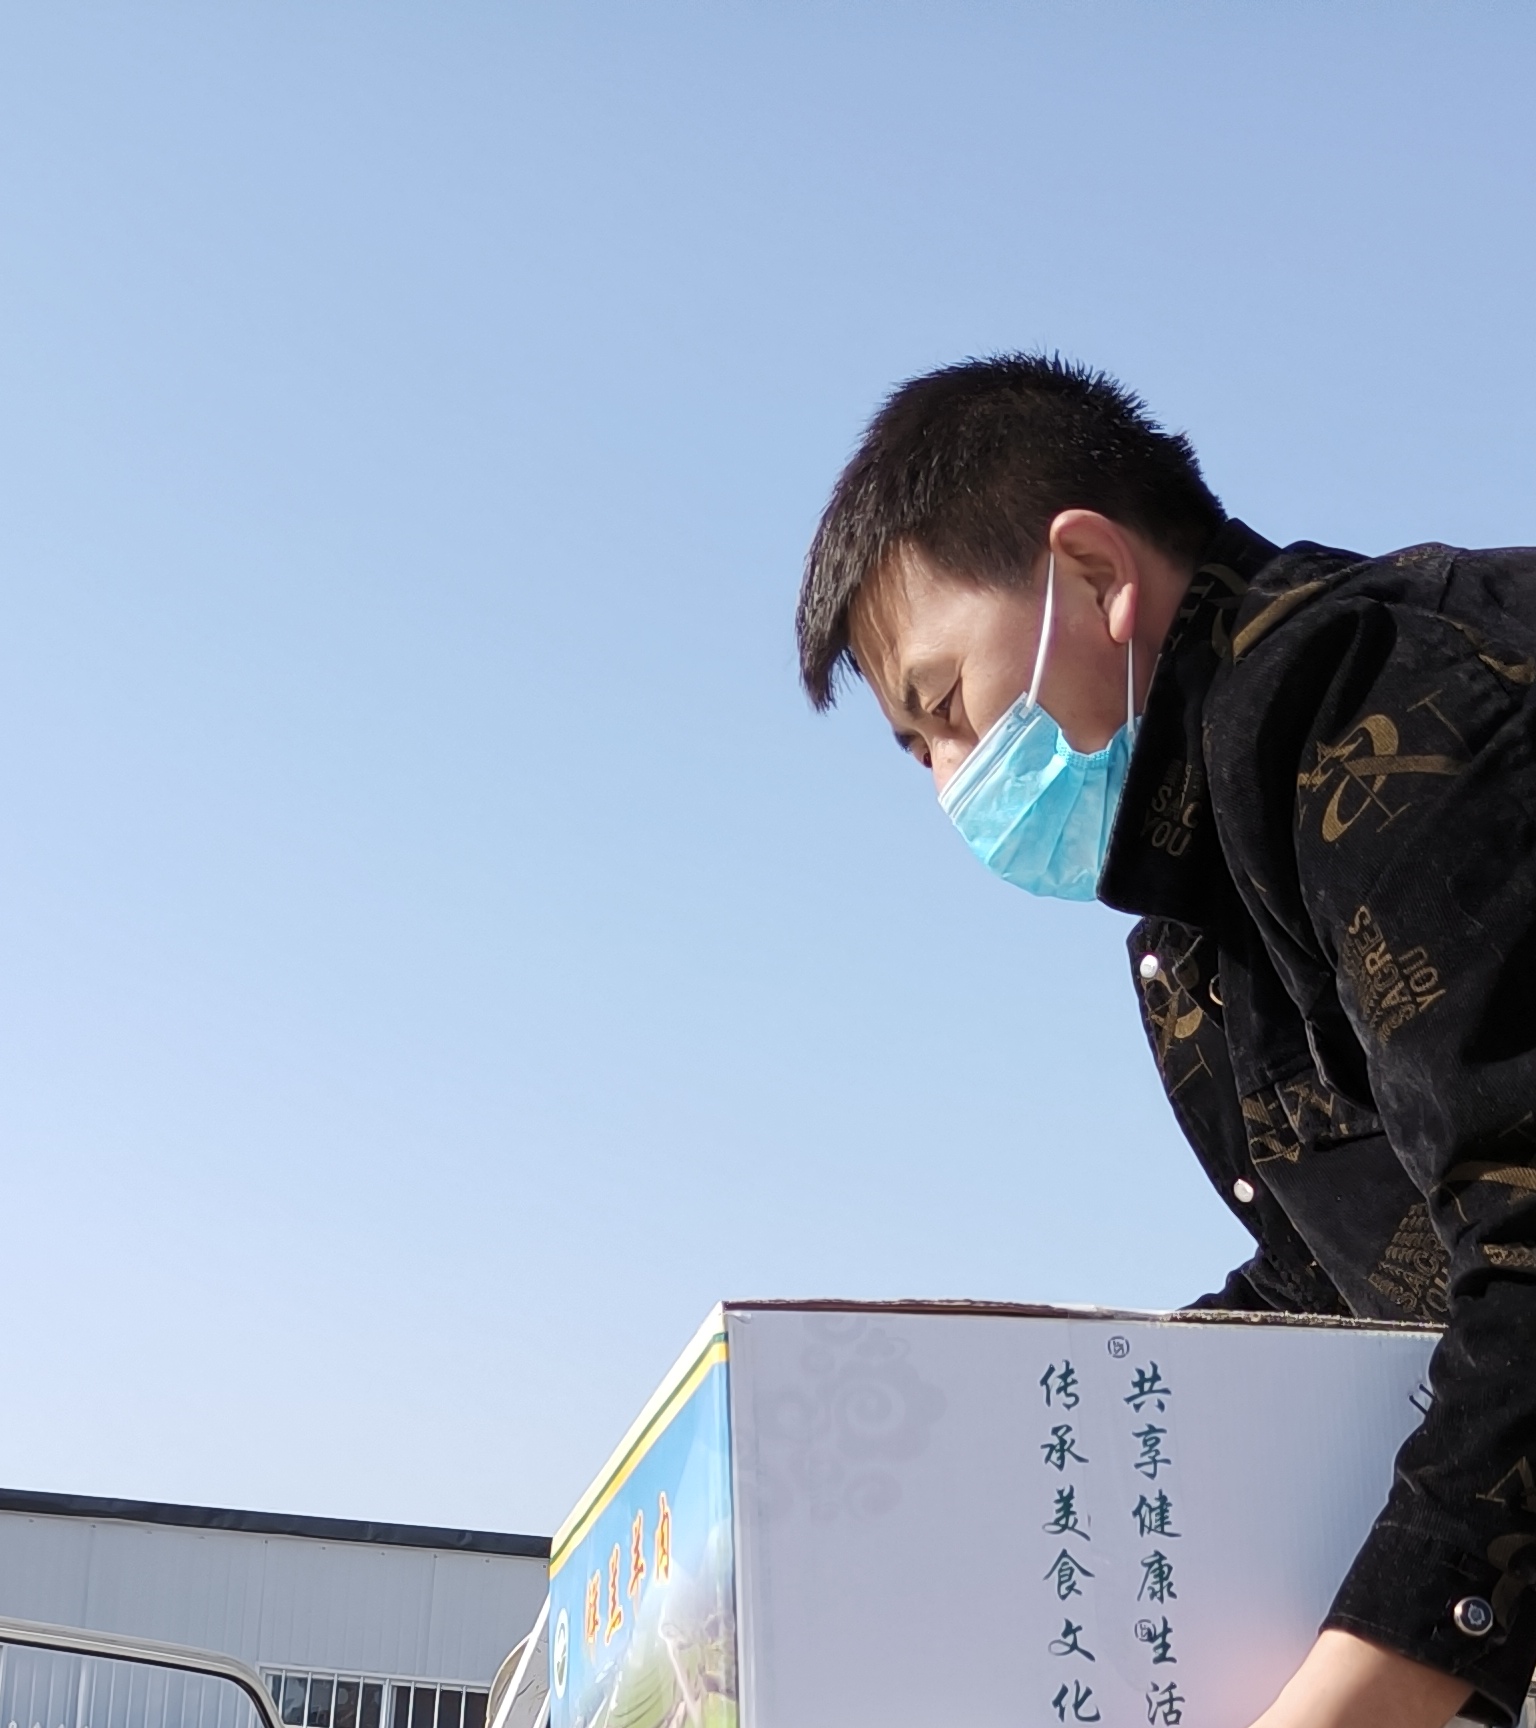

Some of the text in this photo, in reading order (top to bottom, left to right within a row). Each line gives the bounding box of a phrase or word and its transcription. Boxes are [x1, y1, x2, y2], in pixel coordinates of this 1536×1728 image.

[1040, 1360, 1100, 1722] 传承美食文化
[1123, 1361, 1186, 1727] 共享健康生活
